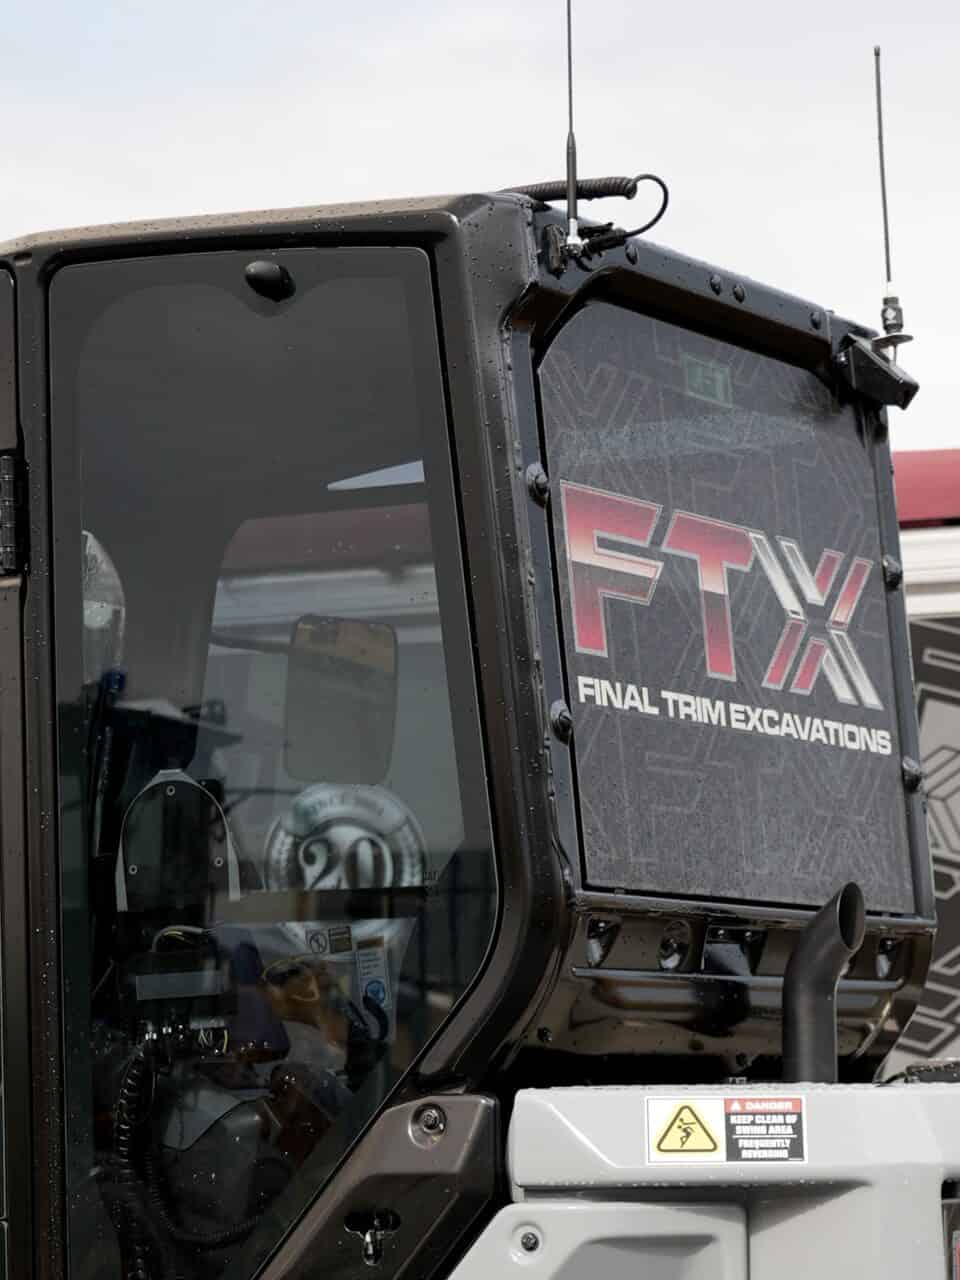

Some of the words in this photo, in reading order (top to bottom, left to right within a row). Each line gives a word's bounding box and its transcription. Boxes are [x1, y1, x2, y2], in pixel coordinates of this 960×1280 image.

[559, 479, 884, 710] FTX
[577, 675, 660, 715] FINAL
[660, 690, 727, 727] TRIM
[729, 703, 892, 756] EXCAVATIONS
